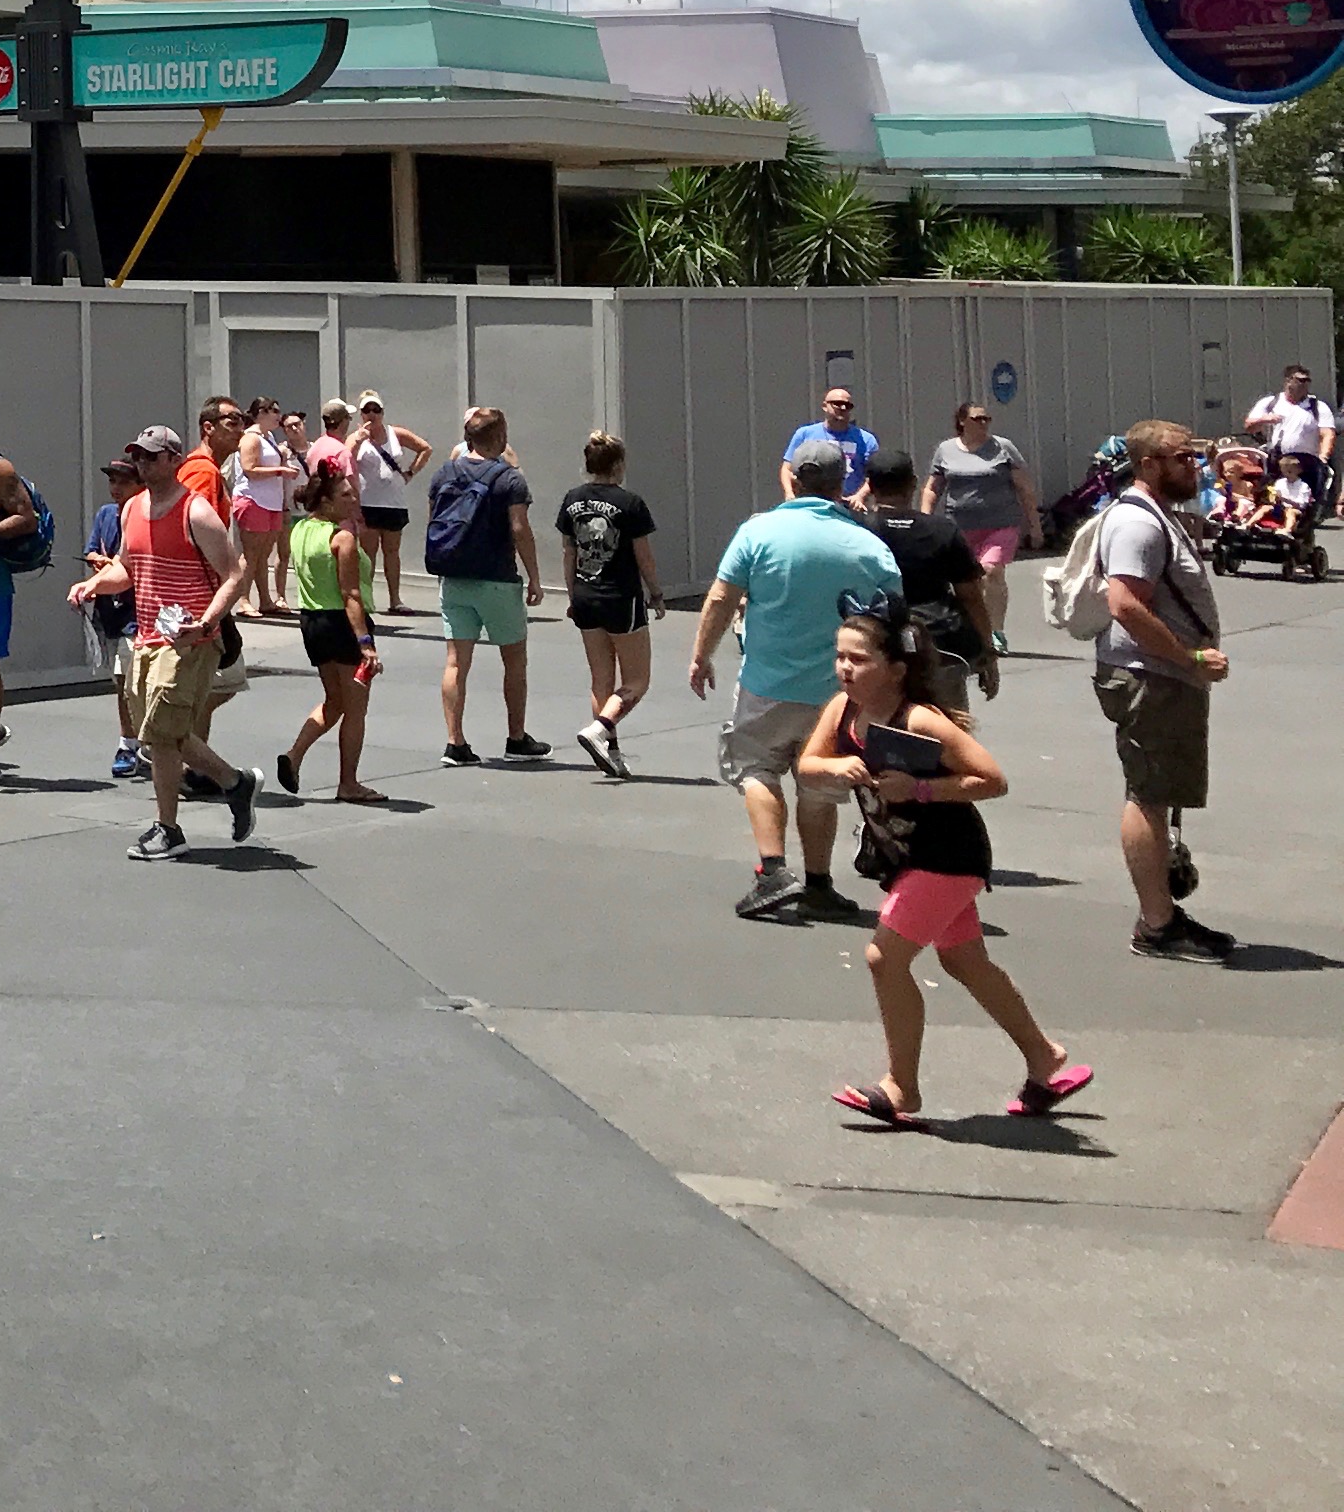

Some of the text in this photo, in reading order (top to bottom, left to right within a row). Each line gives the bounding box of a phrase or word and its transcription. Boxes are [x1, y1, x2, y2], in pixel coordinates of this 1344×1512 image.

[127, 41, 182, 57] Csmic
[87, 57, 278, 93] STARLIGHT CAFE
[566, 500, 622, 518] THE STORY
